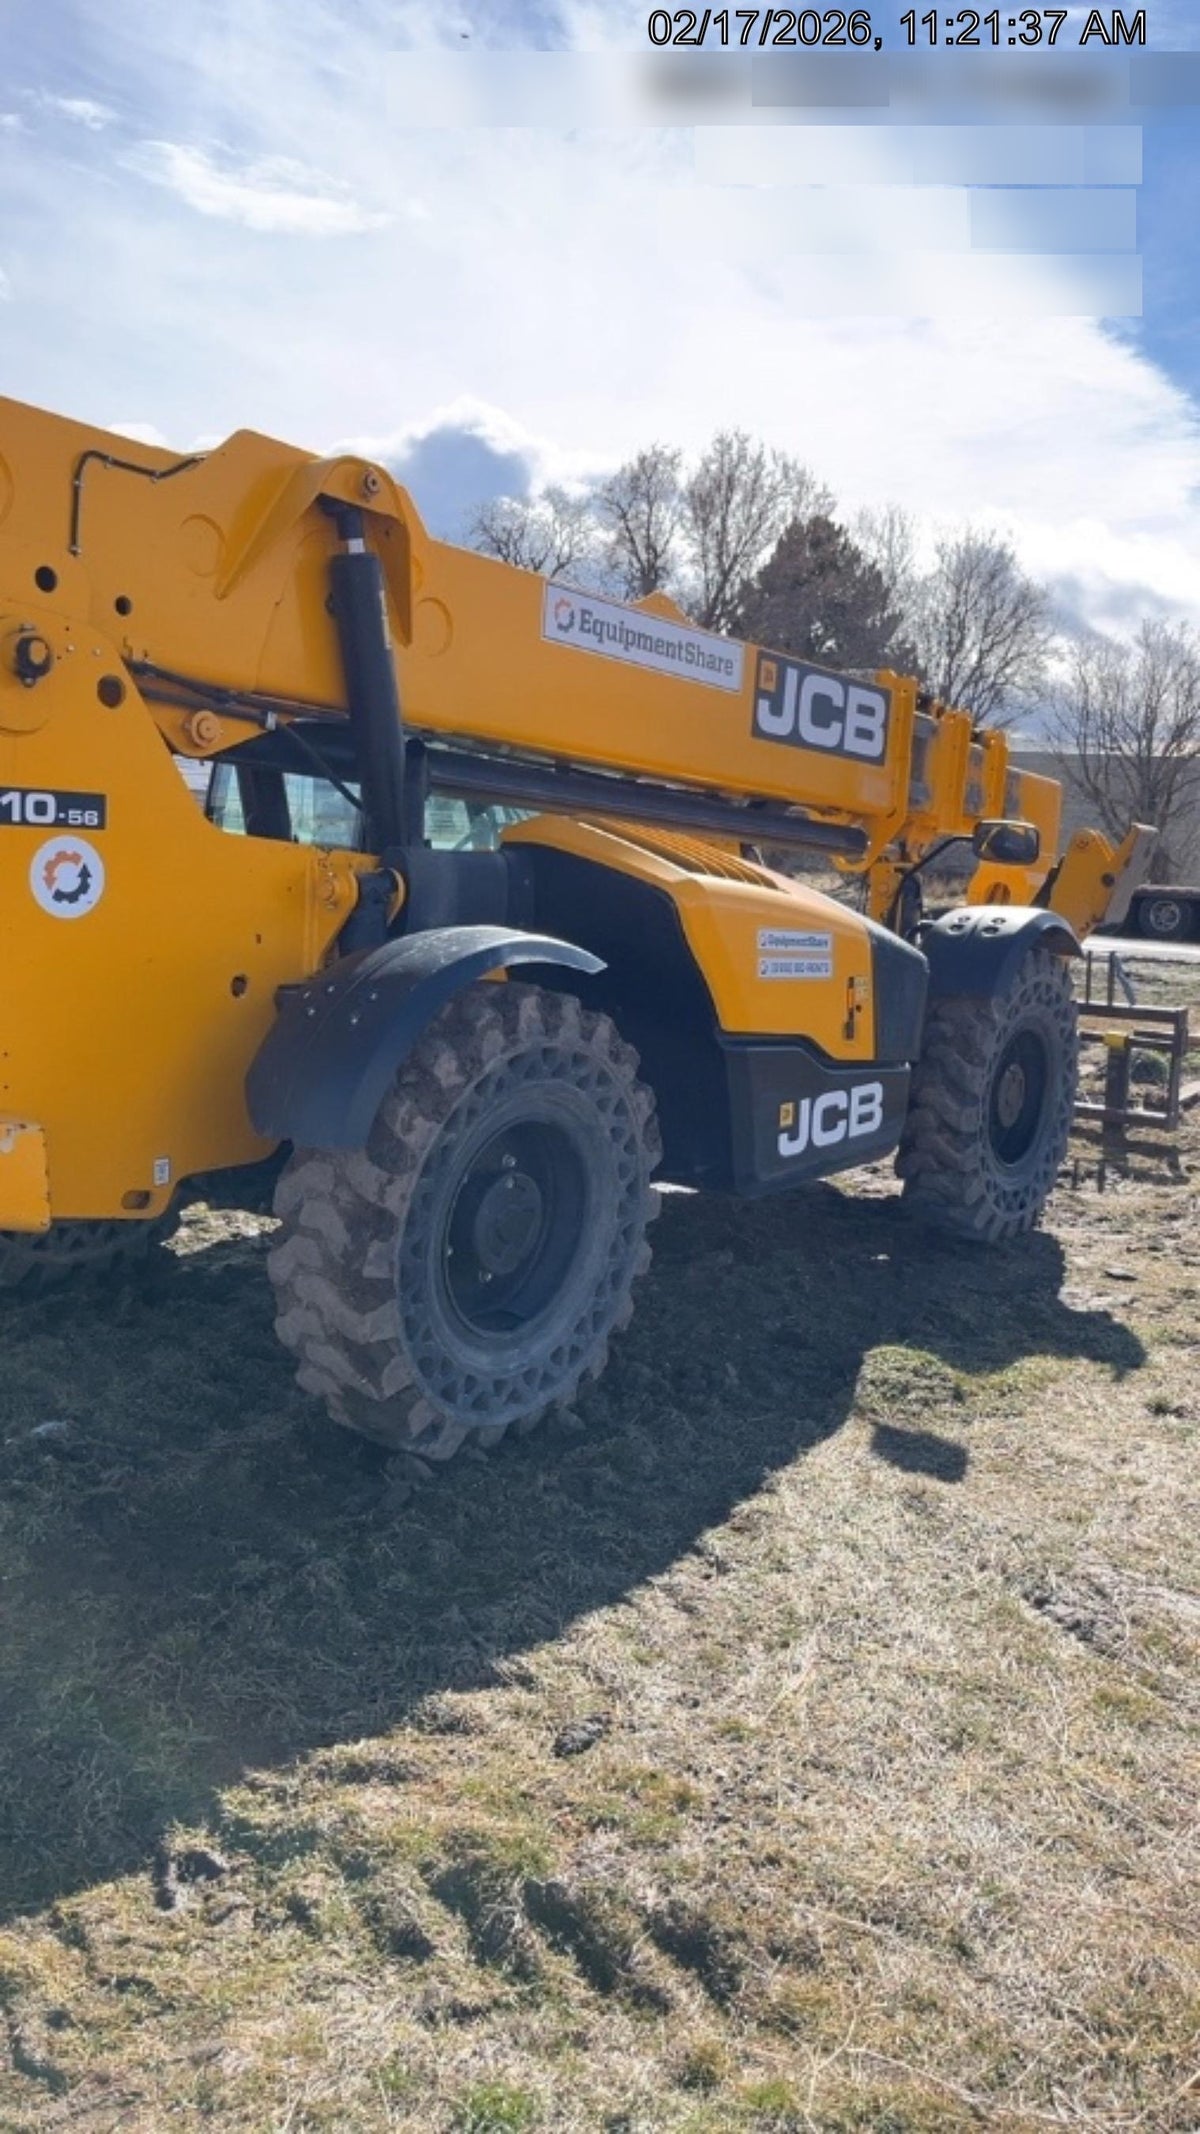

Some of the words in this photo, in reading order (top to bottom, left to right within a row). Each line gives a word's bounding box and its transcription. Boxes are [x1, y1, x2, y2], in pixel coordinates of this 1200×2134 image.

[578, 608, 734, 676] EquipmentShare
[757, 667, 886, 758] JCB
[777, 1081, 883, 1157] JCB
